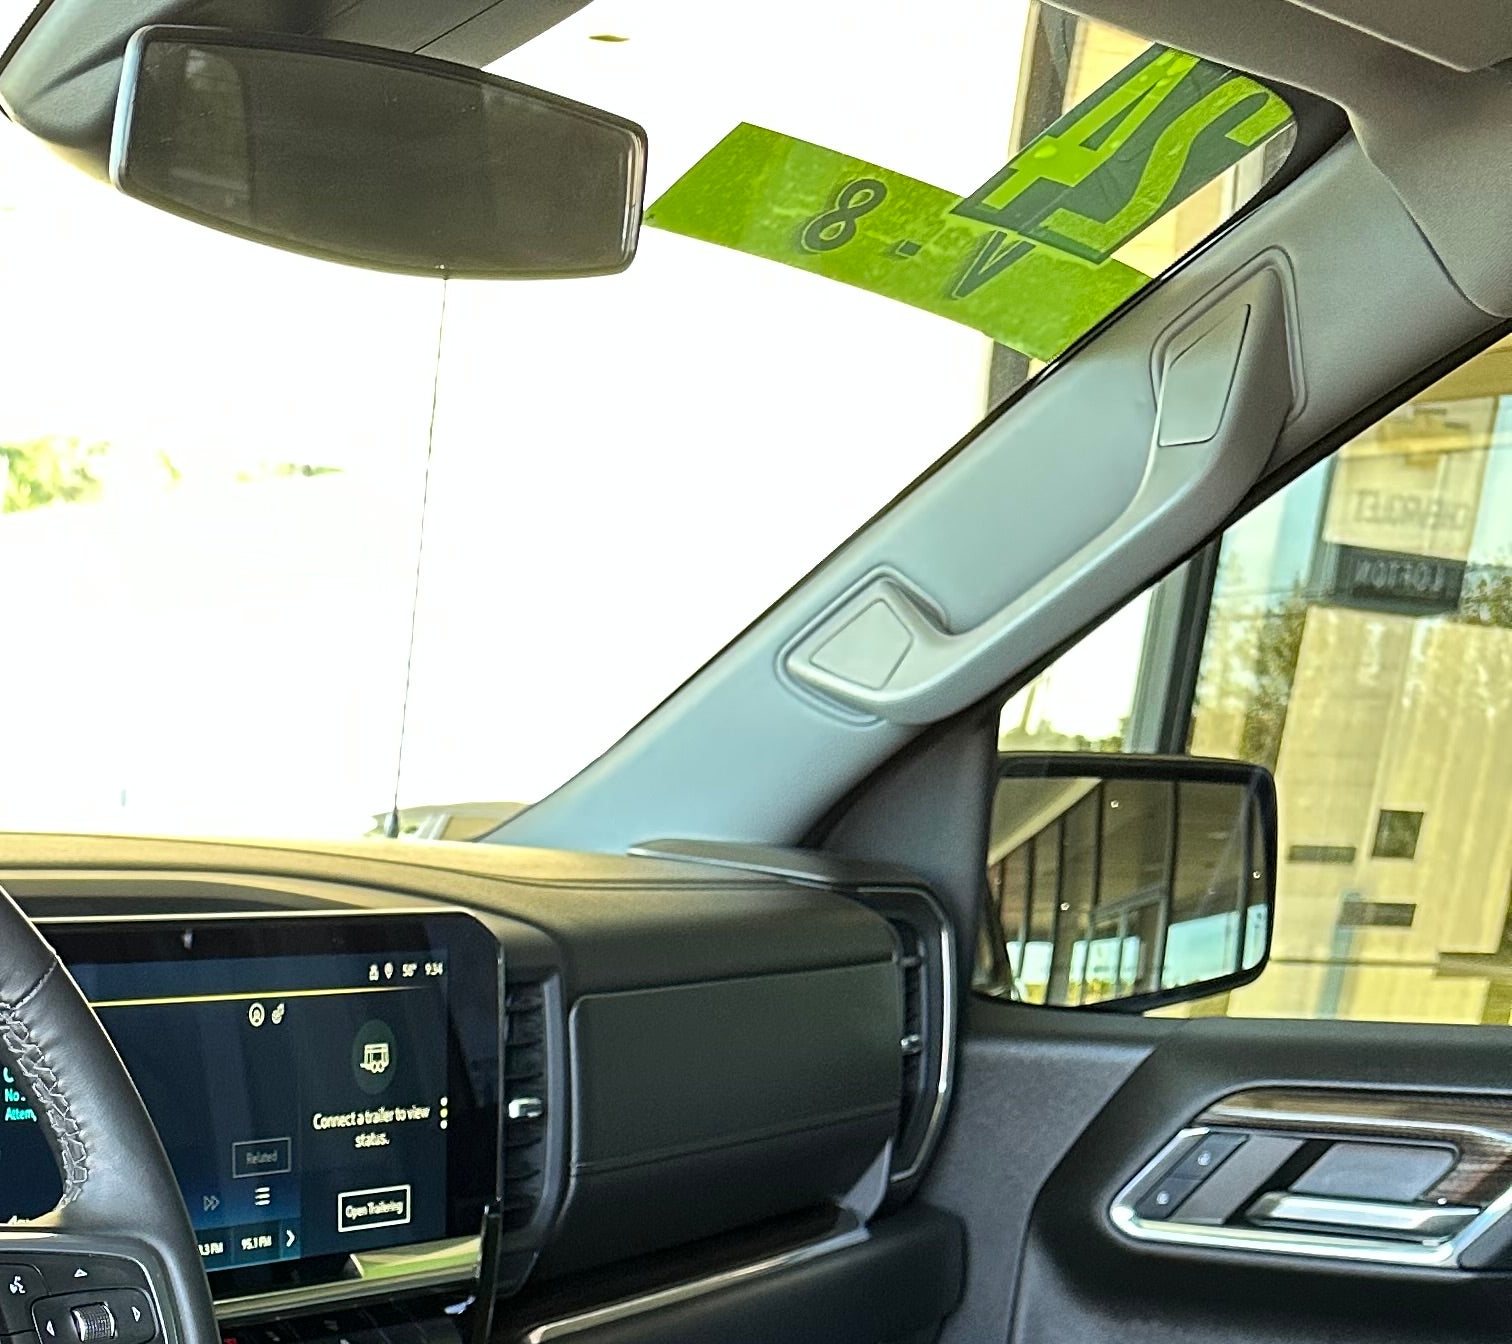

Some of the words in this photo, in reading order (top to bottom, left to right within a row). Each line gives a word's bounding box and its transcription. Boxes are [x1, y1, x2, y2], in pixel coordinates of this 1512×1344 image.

[313, 1111, 356, 1131] Connect
[365, 1106, 394, 1125] trailer
[395, 1107, 407, 1122] to
[407, 1104, 431, 1120] view
[345, 1204, 368, 1221] Open
